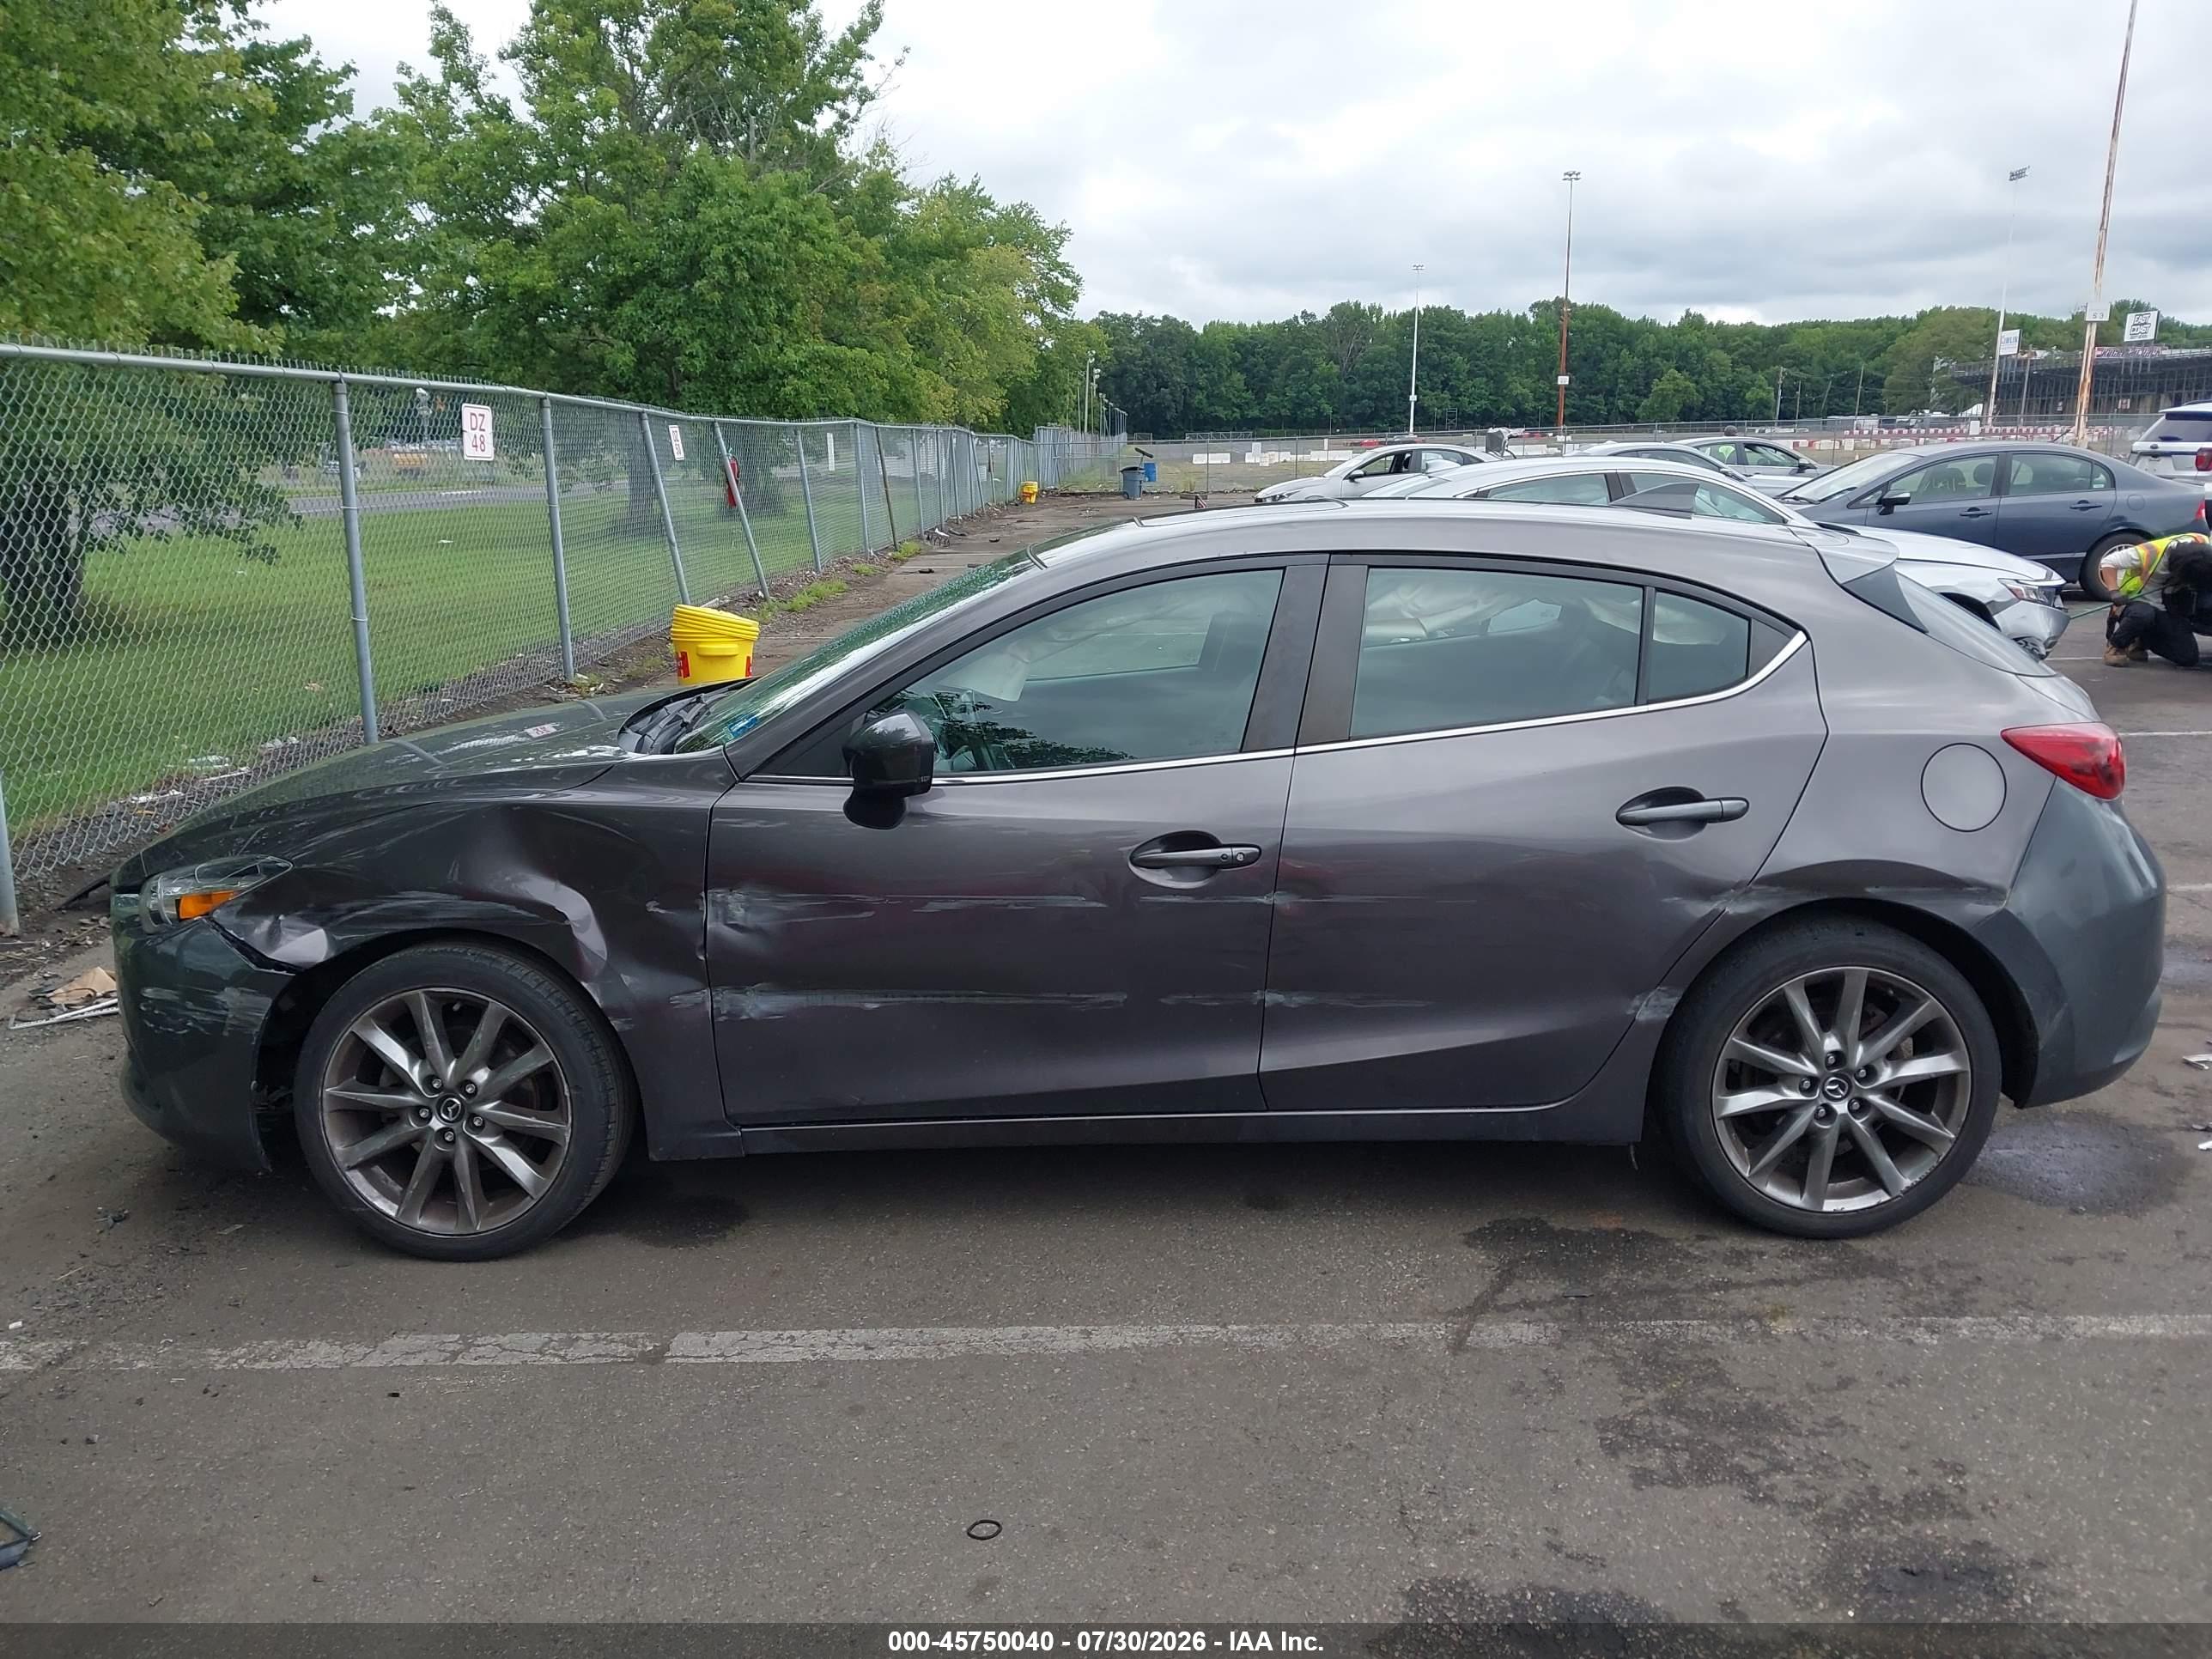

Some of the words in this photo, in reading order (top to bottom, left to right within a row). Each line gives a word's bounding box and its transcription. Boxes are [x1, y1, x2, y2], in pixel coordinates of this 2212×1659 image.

[2133, 313, 2151, 325] EAST
[2130, 324, 2151, 336] COAST
[470, 412, 486, 432] DZ
[471, 433, 486, 453] 48
